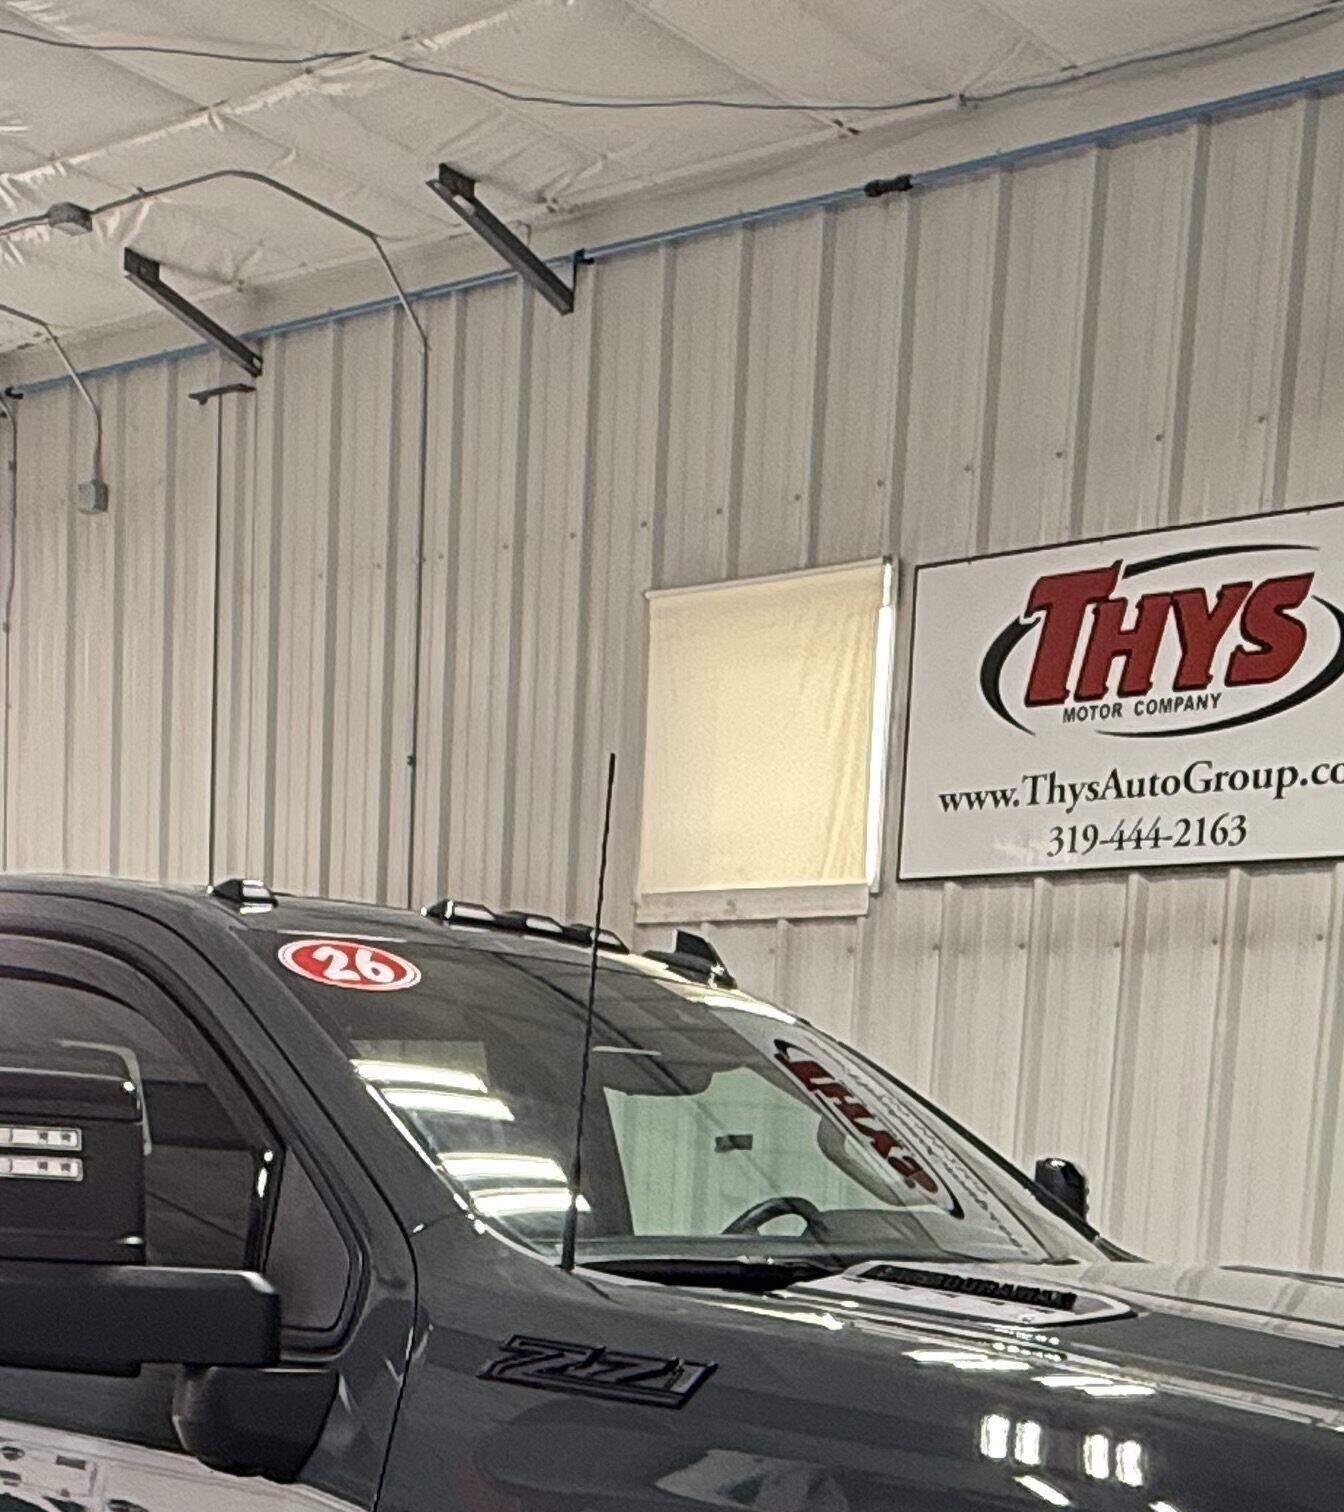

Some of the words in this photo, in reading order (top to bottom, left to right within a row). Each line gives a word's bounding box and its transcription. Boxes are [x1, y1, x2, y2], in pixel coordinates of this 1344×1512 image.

[1024, 560, 1315, 709] THYS
[1062, 703, 1123, 724] MOTOR
[1133, 692, 1223, 717] COMPANY
[1046, 813, 1248, 858] 319-444-2163
[312, 945, 396, 984] 26
[477, 1333, 719, 1410] Z71
